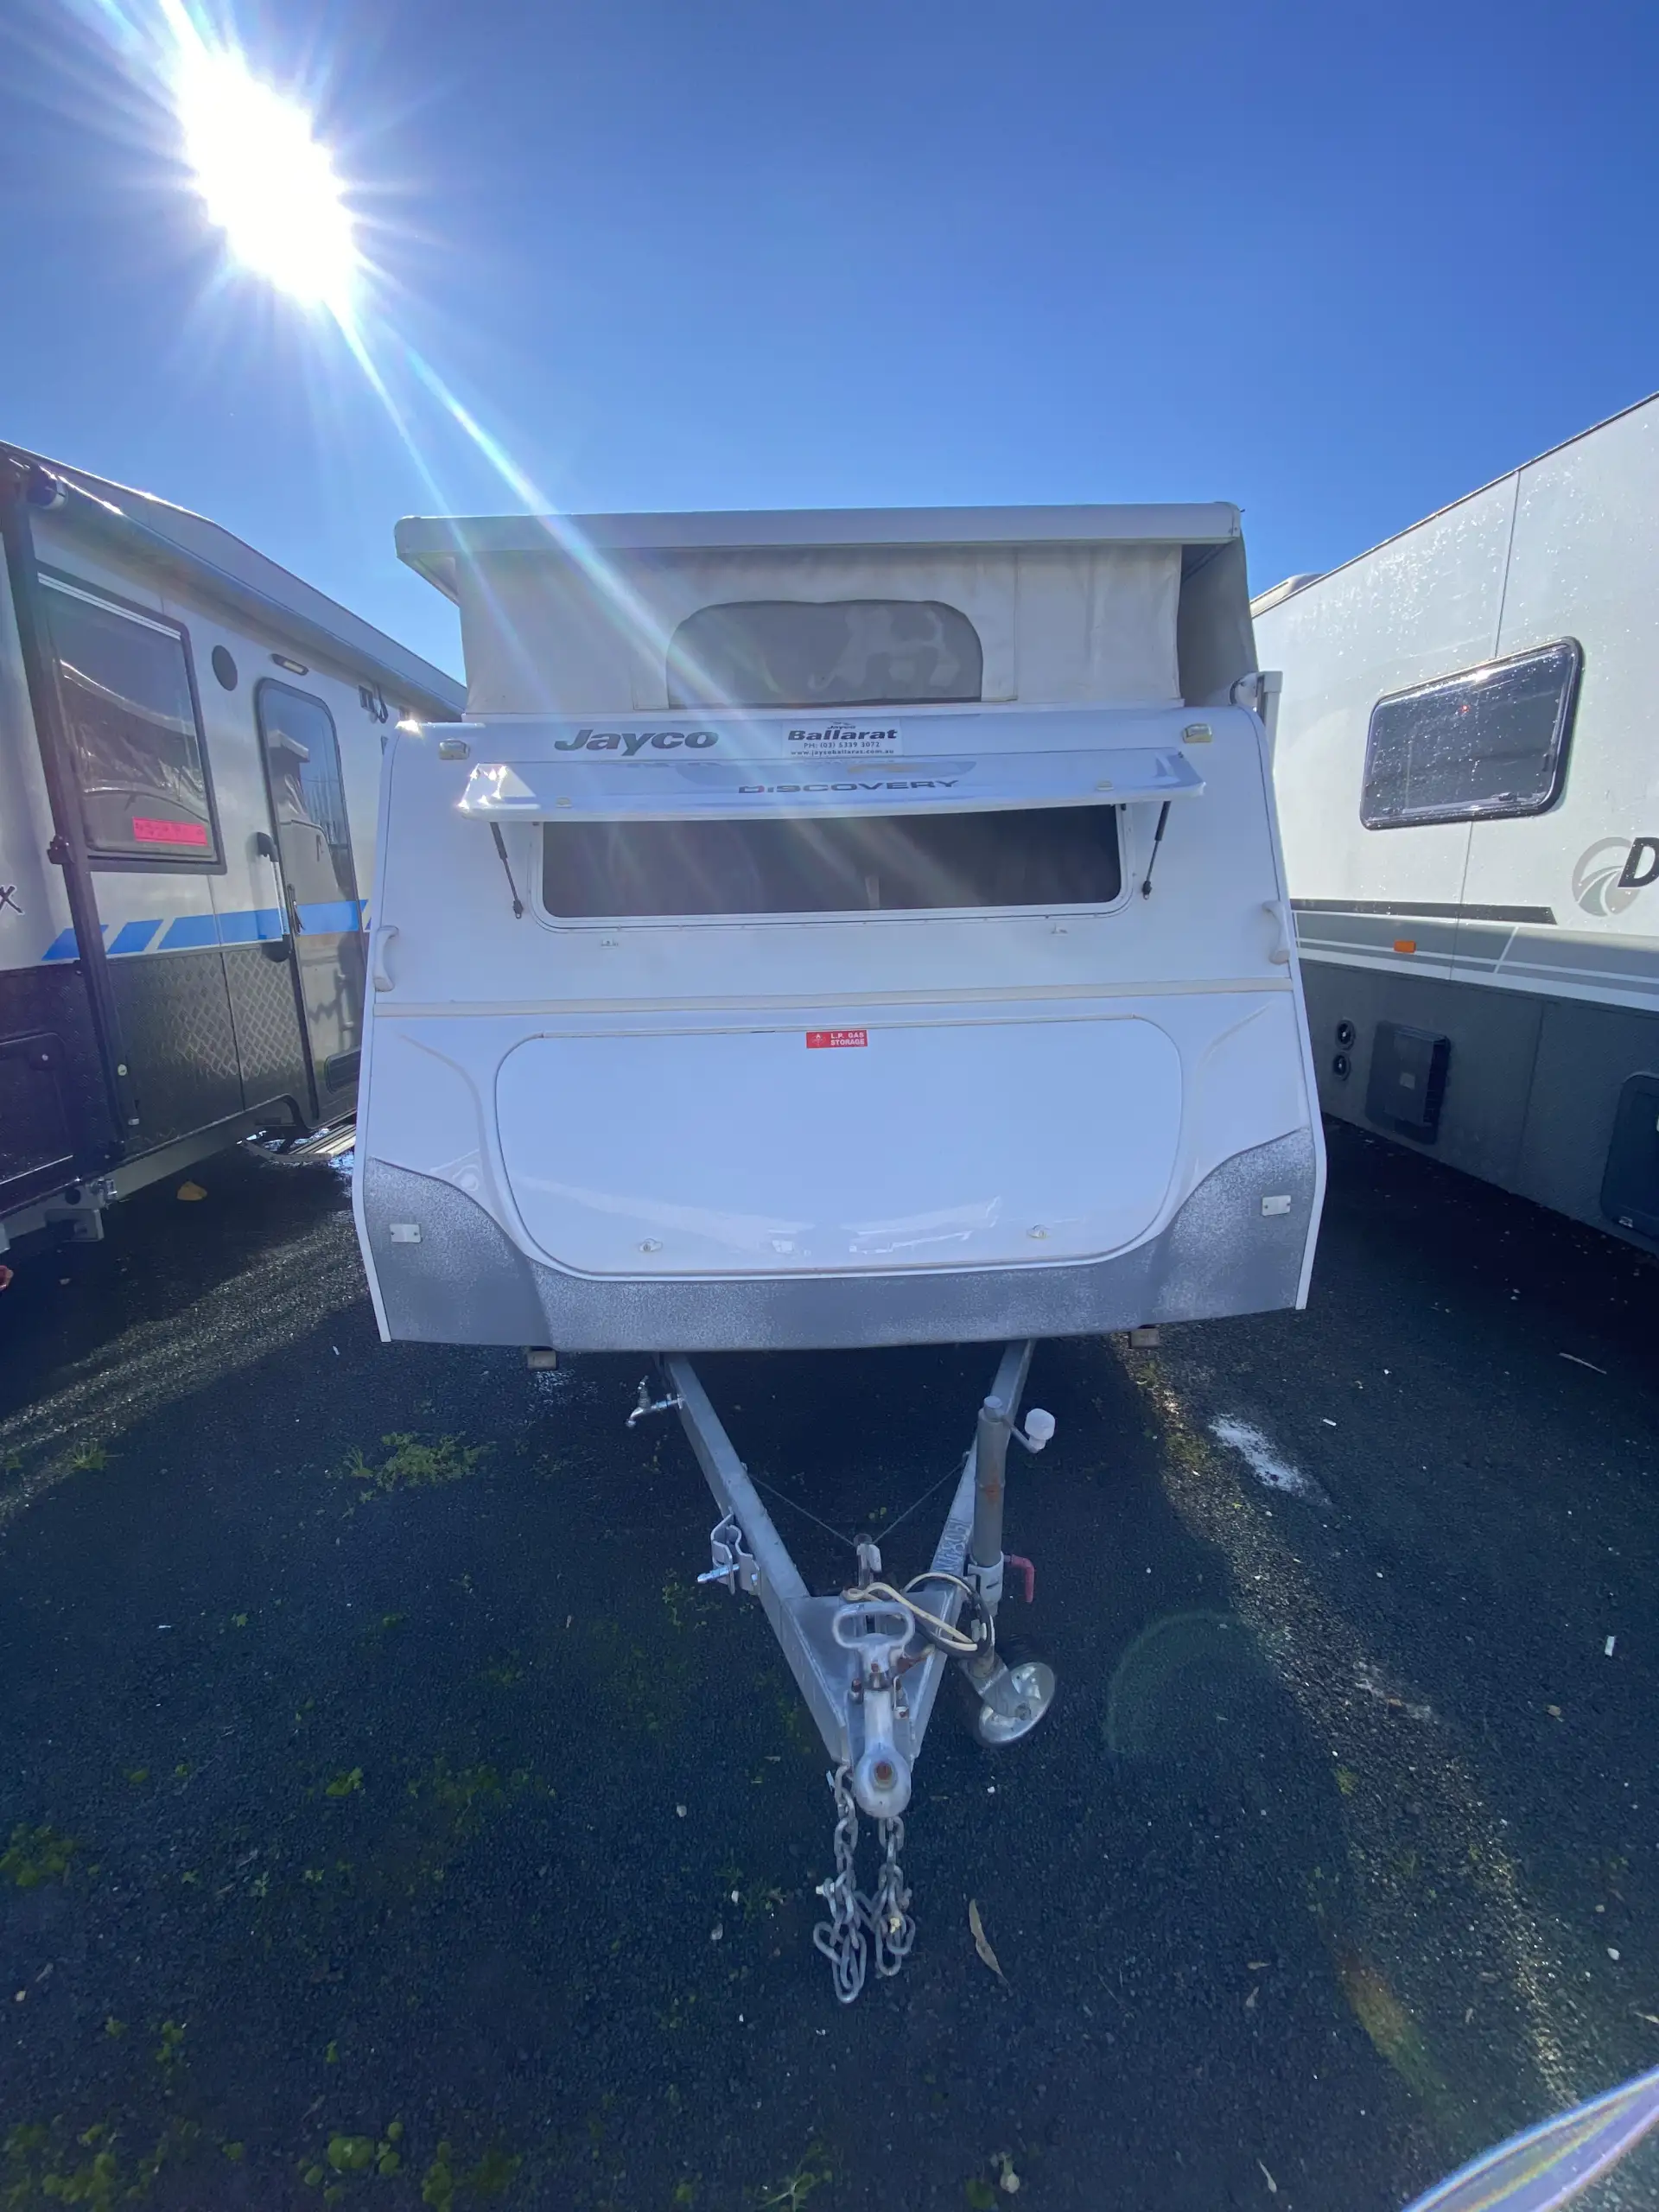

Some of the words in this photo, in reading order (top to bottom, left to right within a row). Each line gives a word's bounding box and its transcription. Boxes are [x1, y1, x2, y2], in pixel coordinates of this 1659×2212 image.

[787, 729, 898, 741] Ballarat
[554, 728, 719, 757] Jayco
[830, 1038, 865, 1046] STORAGE
